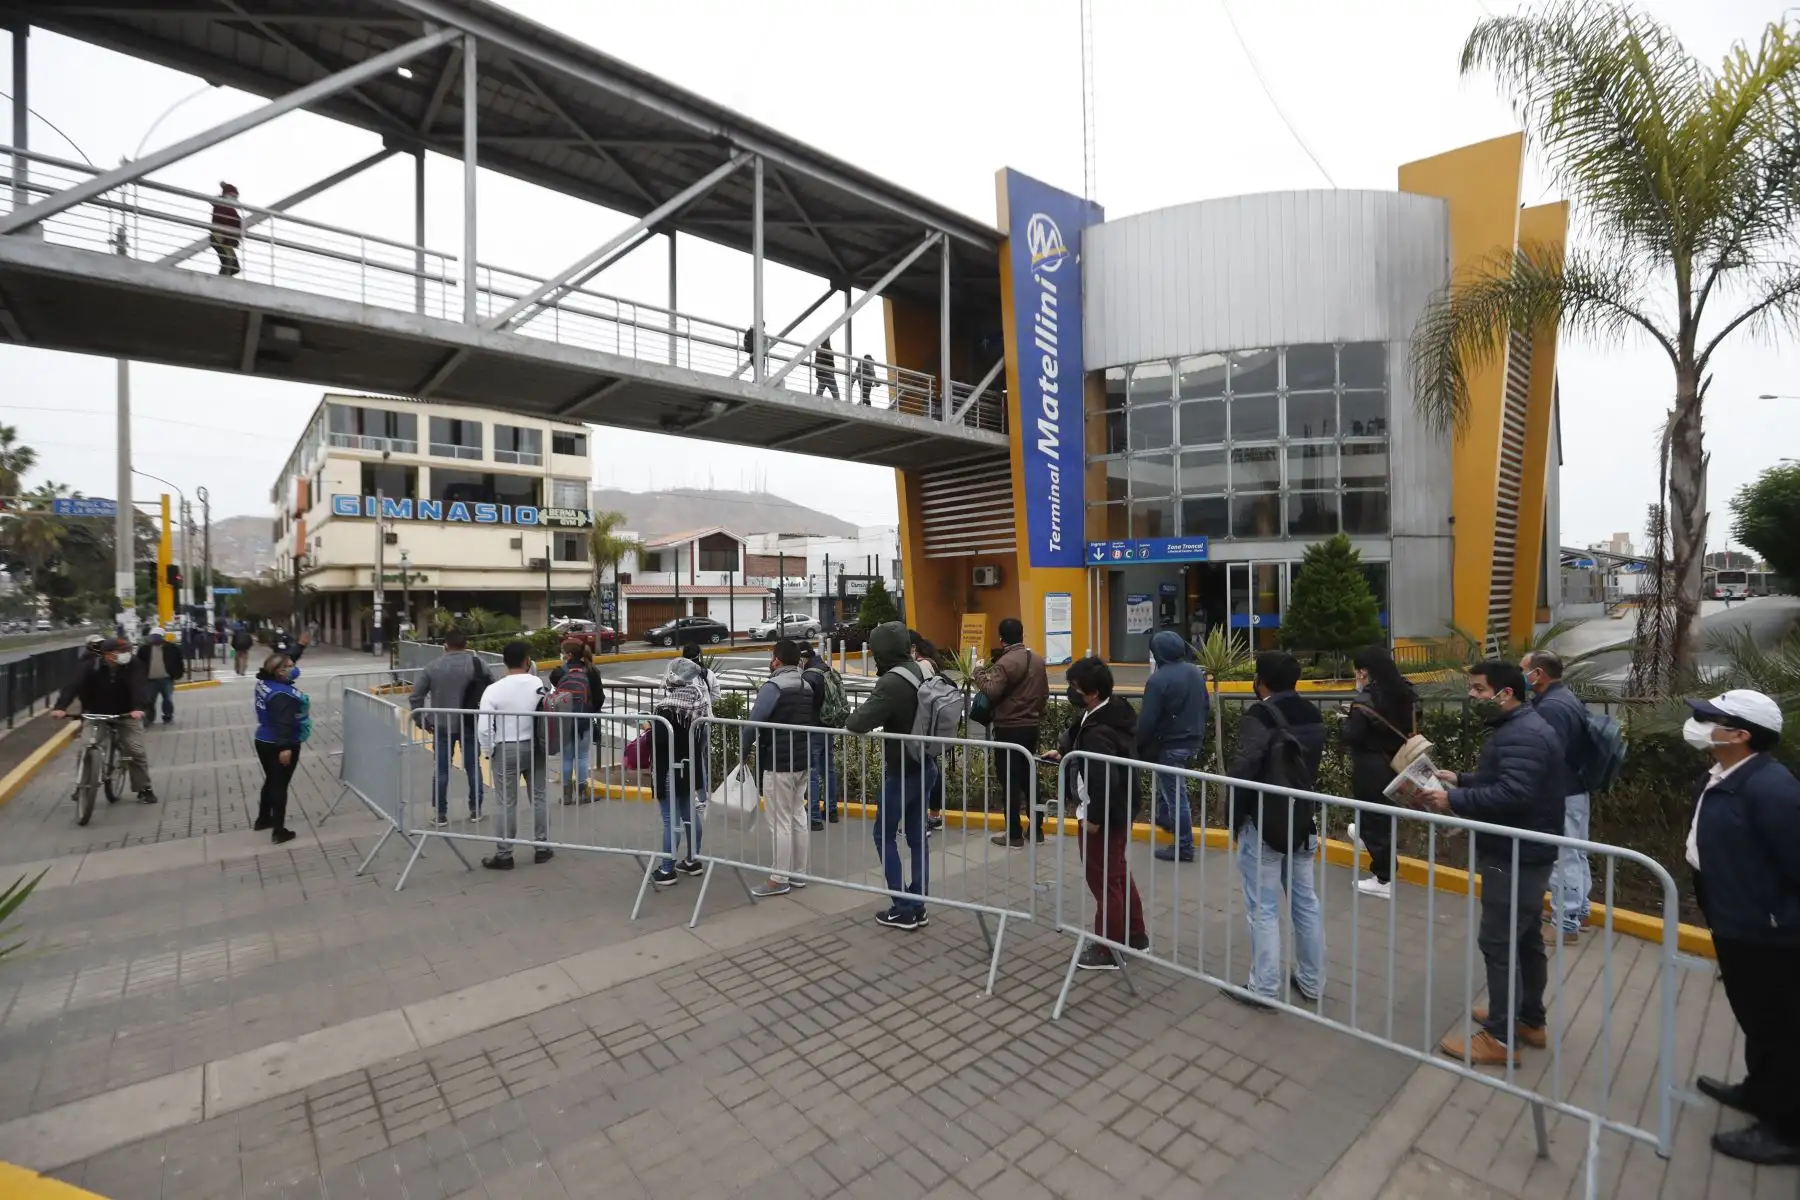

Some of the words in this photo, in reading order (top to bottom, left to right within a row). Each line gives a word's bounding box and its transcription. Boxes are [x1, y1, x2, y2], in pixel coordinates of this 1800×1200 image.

[1035, 274, 1060, 460] Matellini
[333, 495, 539, 525] GIMNASIO
[1049, 463, 1062, 552] Terminal
[1182, 542, 1204, 550] Troncal
